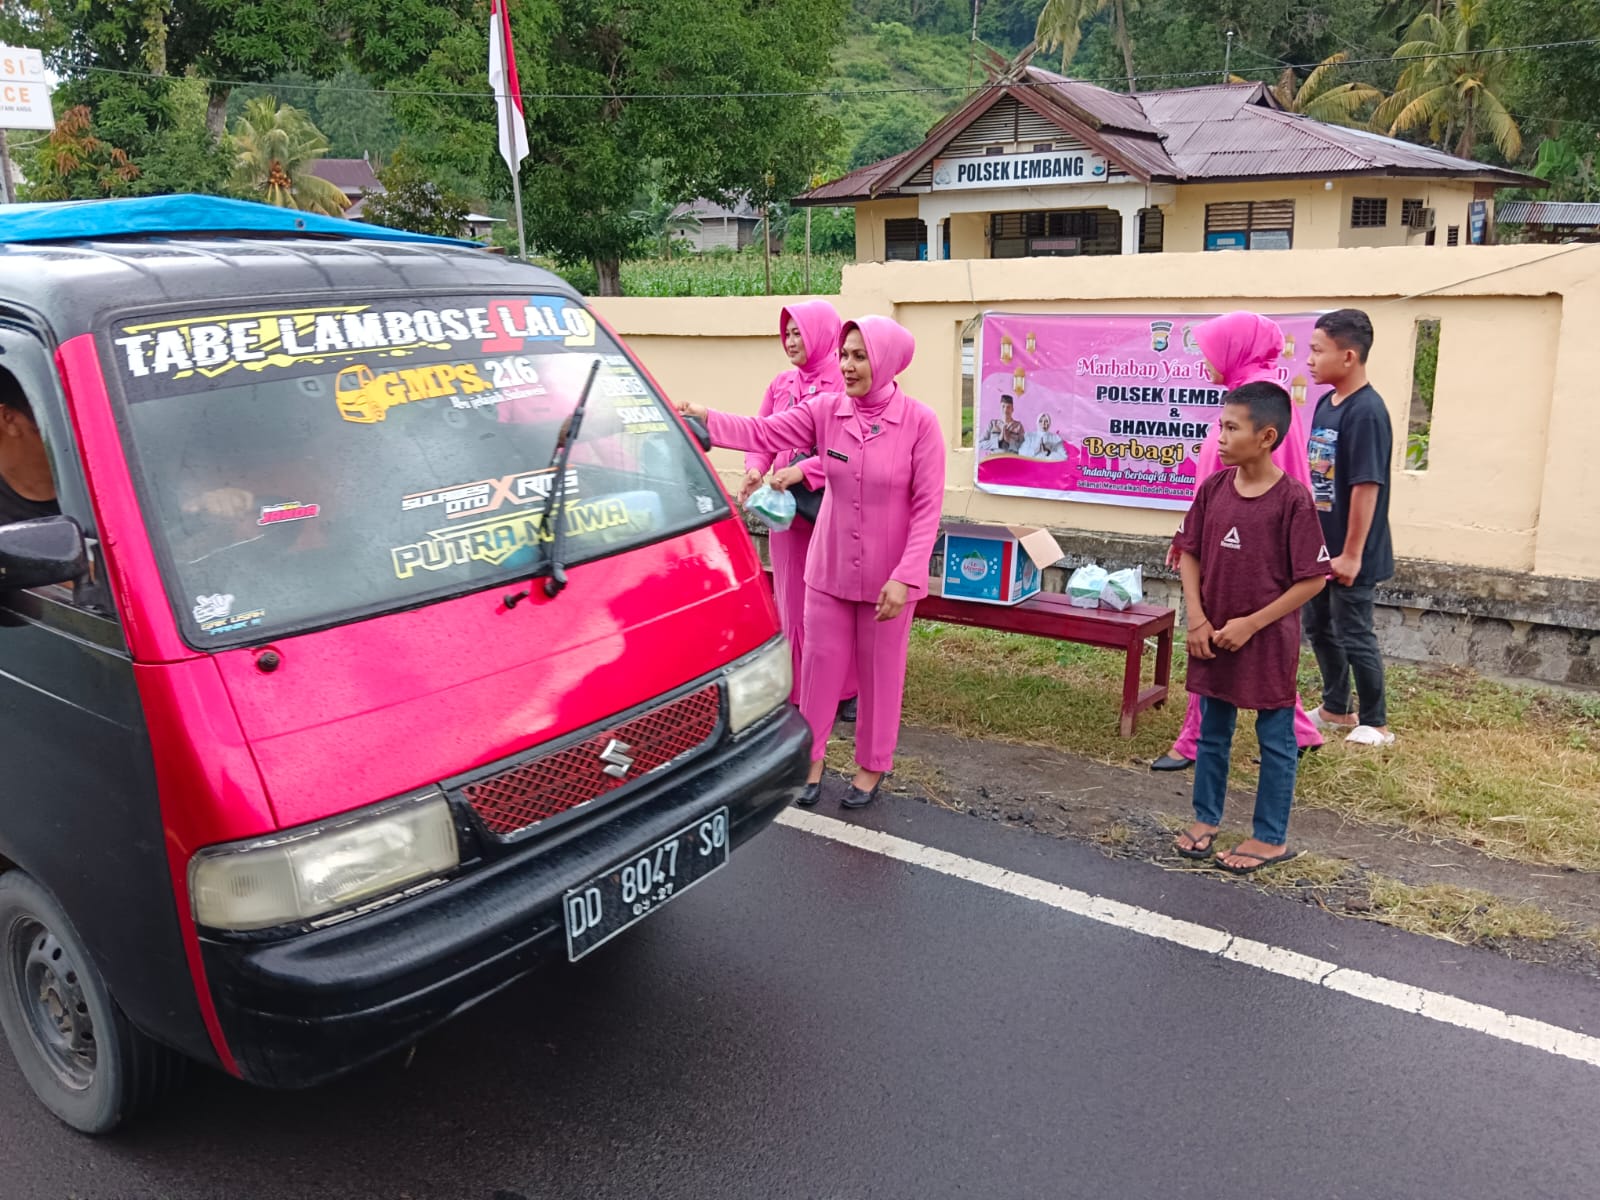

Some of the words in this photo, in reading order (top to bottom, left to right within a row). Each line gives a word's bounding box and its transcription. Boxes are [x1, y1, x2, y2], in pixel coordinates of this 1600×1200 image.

[957, 159, 1010, 183] POLSEK
[1013, 156, 1084, 180] LEMBANG
[115, 321, 265, 378] TABE
[278, 307, 496, 354] LAMBOSE
[497, 306, 589, 337] LALO
[1078, 358, 1158, 379] Marhaban
[1160, 360, 1190, 382] Yaa
[1096, 385, 1164, 404] POLSEK
[1169, 407, 1181, 418] &
[1083, 436, 1184, 466] Berbagi
[1124, 470, 1158, 483] Berbagi
[1158, 472, 1167, 482] di
[446, 493, 489, 514] OTO
[569, 887, 602, 938] DD
[621, 839, 680, 903] 8047
